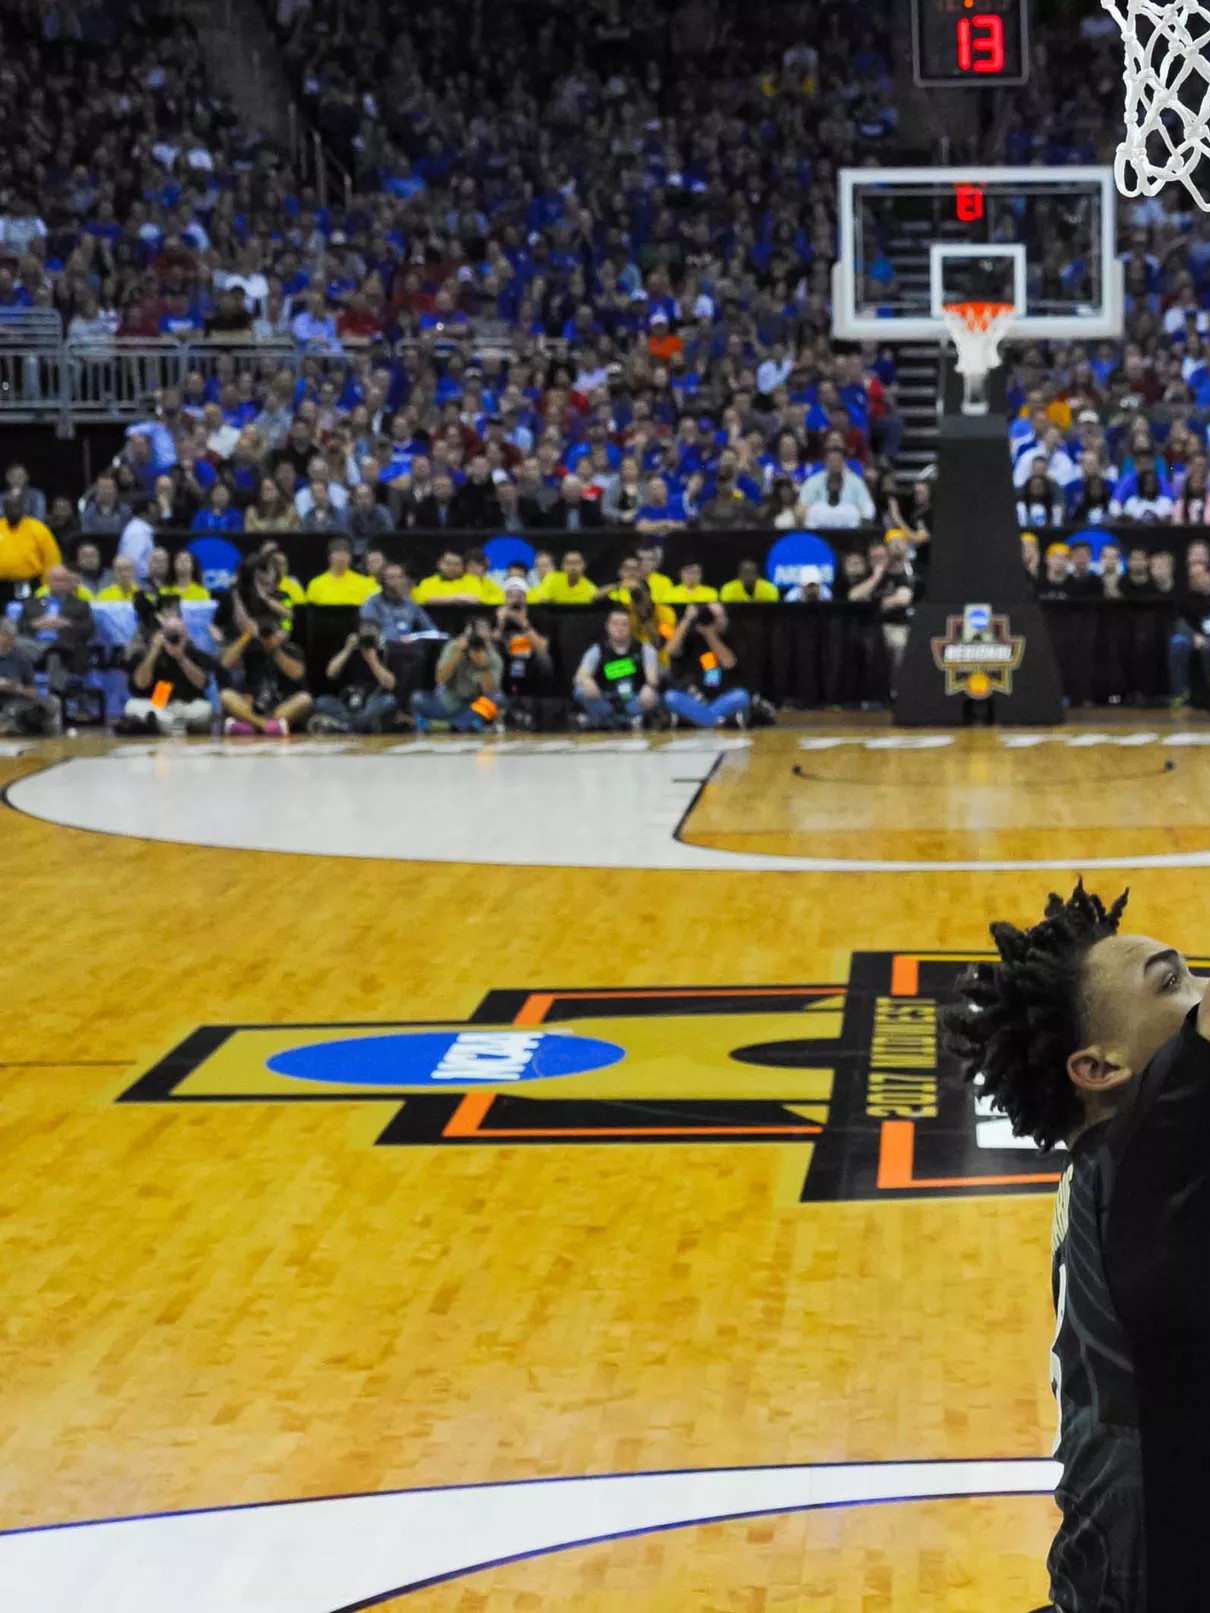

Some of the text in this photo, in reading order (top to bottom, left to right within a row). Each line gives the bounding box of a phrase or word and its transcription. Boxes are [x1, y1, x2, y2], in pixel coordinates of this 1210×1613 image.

[957, 14, 1004, 73] 13
[430, 1031, 547, 1079] NCAA
[866, 997, 938, 1117] 2017 MIDWEST
